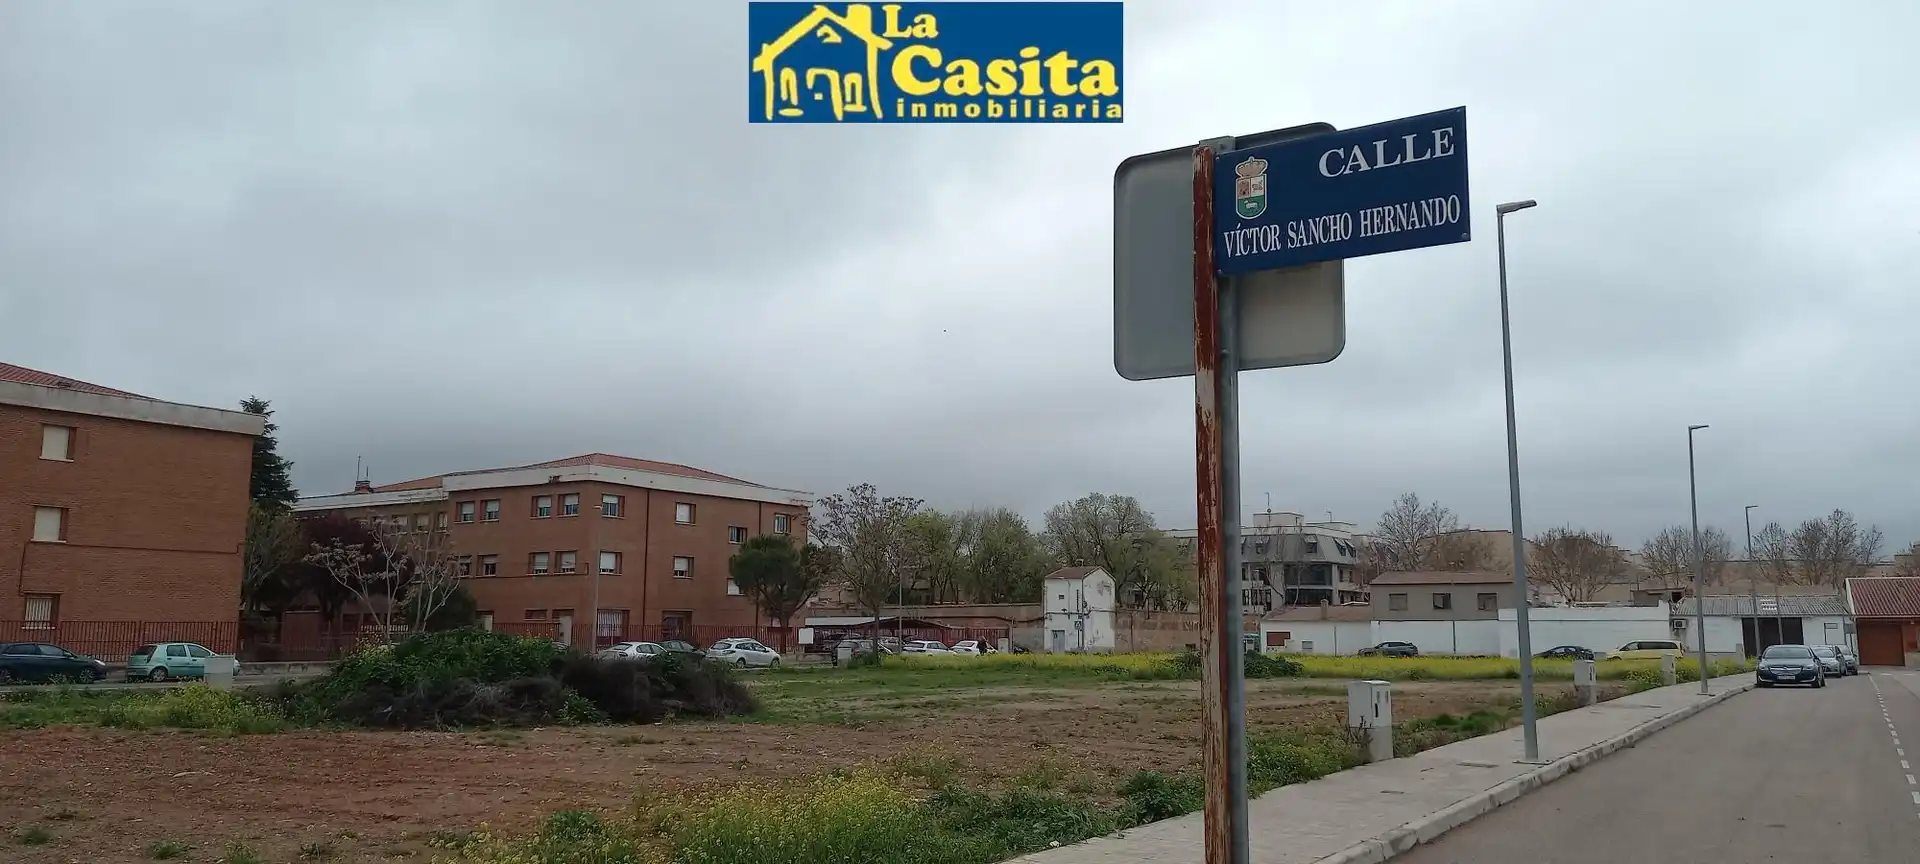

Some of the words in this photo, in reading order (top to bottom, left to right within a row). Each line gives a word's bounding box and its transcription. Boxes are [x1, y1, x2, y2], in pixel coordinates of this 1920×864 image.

[1318, 126, 1454, 178] CALLE
[1223, 222, 1282, 258] VÍCTOR
[1287, 212, 1352, 249] SANCHO
[1359, 194, 1461, 238] HERNANDO
